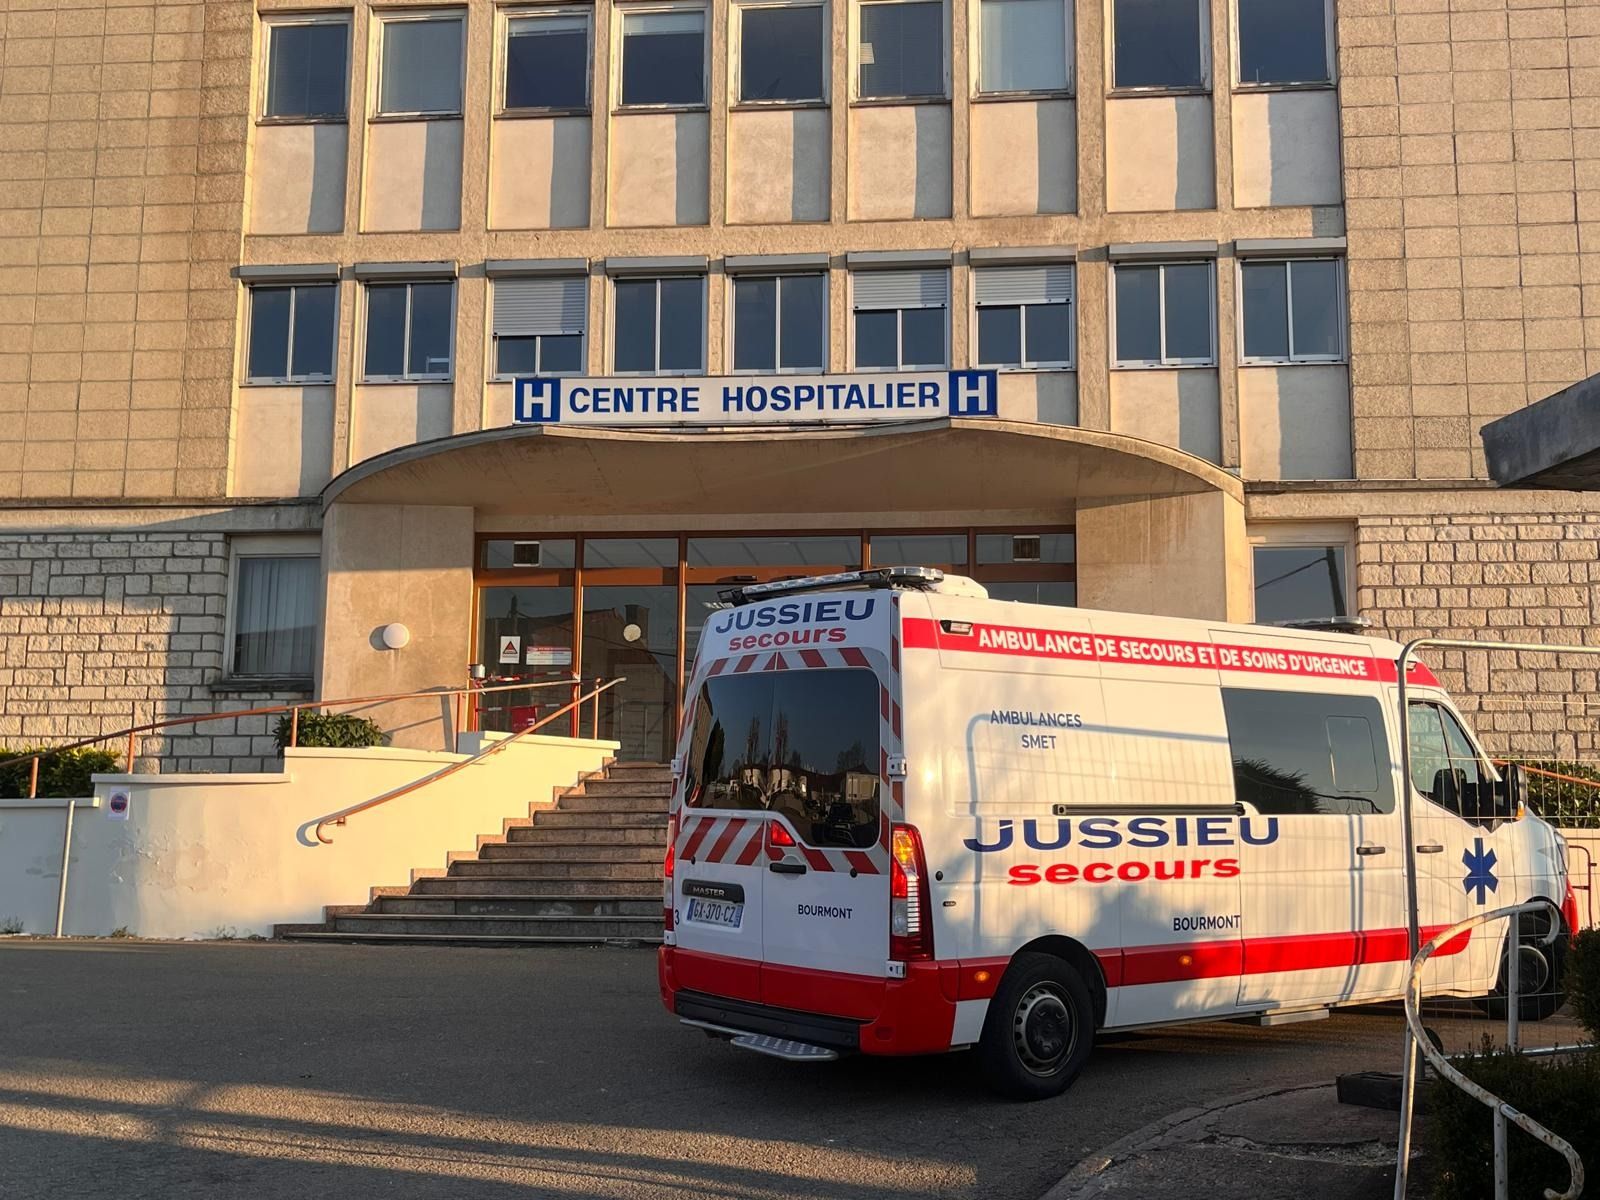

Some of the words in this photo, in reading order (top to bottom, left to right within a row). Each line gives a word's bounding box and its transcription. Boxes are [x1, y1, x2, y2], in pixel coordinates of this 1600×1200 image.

[523, 383, 552, 418] H
[569, 387, 700, 414] CENTRE
[722, 382, 940, 412] HOSPITALIER
[954, 376, 988, 411] H
[729, 627, 847, 650] secours
[979, 629, 1093, 655] AMBULANCE
[1095, 638, 1119, 657] DE
[1119, 642, 1196, 662] SECOURS
[1198, 647, 1217, 664] ET
[1219, 648, 1240, 666] DE
[1242, 650, 1288, 670] SOINS
[1289, 654, 1368, 677] D'URGENCE
[990, 710, 1082, 728] AMBULANCES
[1021, 734, 1057, 749] SMET
[1007, 858, 1241, 886] secours
[693, 886, 725, 897] MASTER
[797, 904, 853, 919] BOURMONT
[1173, 915, 1241, 931] BOURMONT
